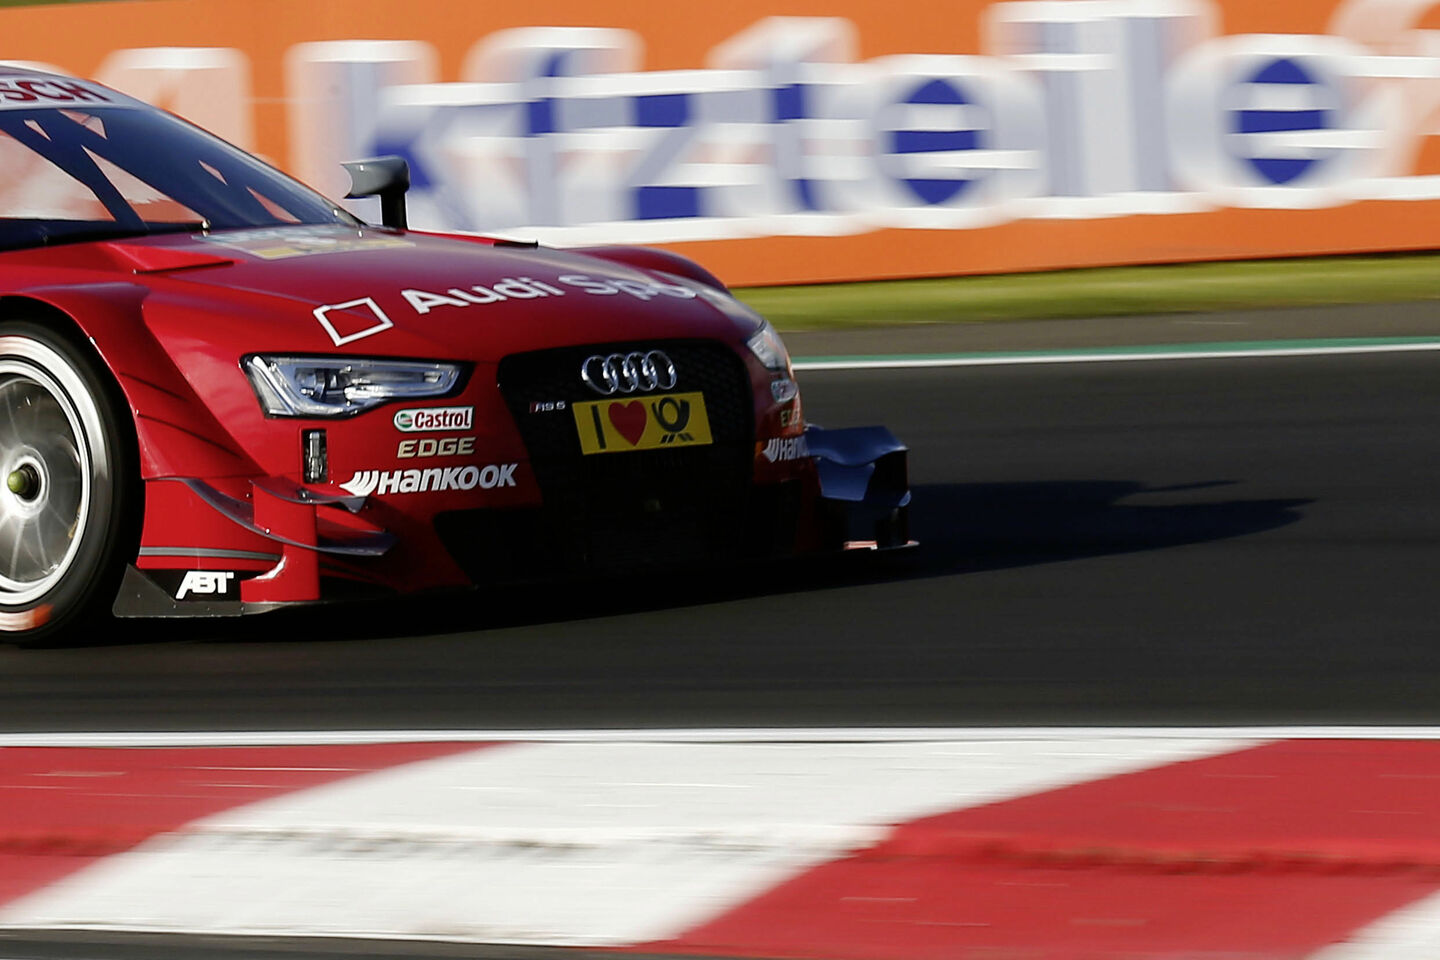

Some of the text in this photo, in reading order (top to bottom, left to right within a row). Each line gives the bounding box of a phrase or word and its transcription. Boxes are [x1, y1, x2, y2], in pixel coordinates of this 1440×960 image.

[401, 277, 565, 314] Audi
[414, 410, 471, 429] Castrol
[591, 404, 606, 450] I
[397, 437, 477, 459] EDGE
[175, 570, 235, 600] ABT
